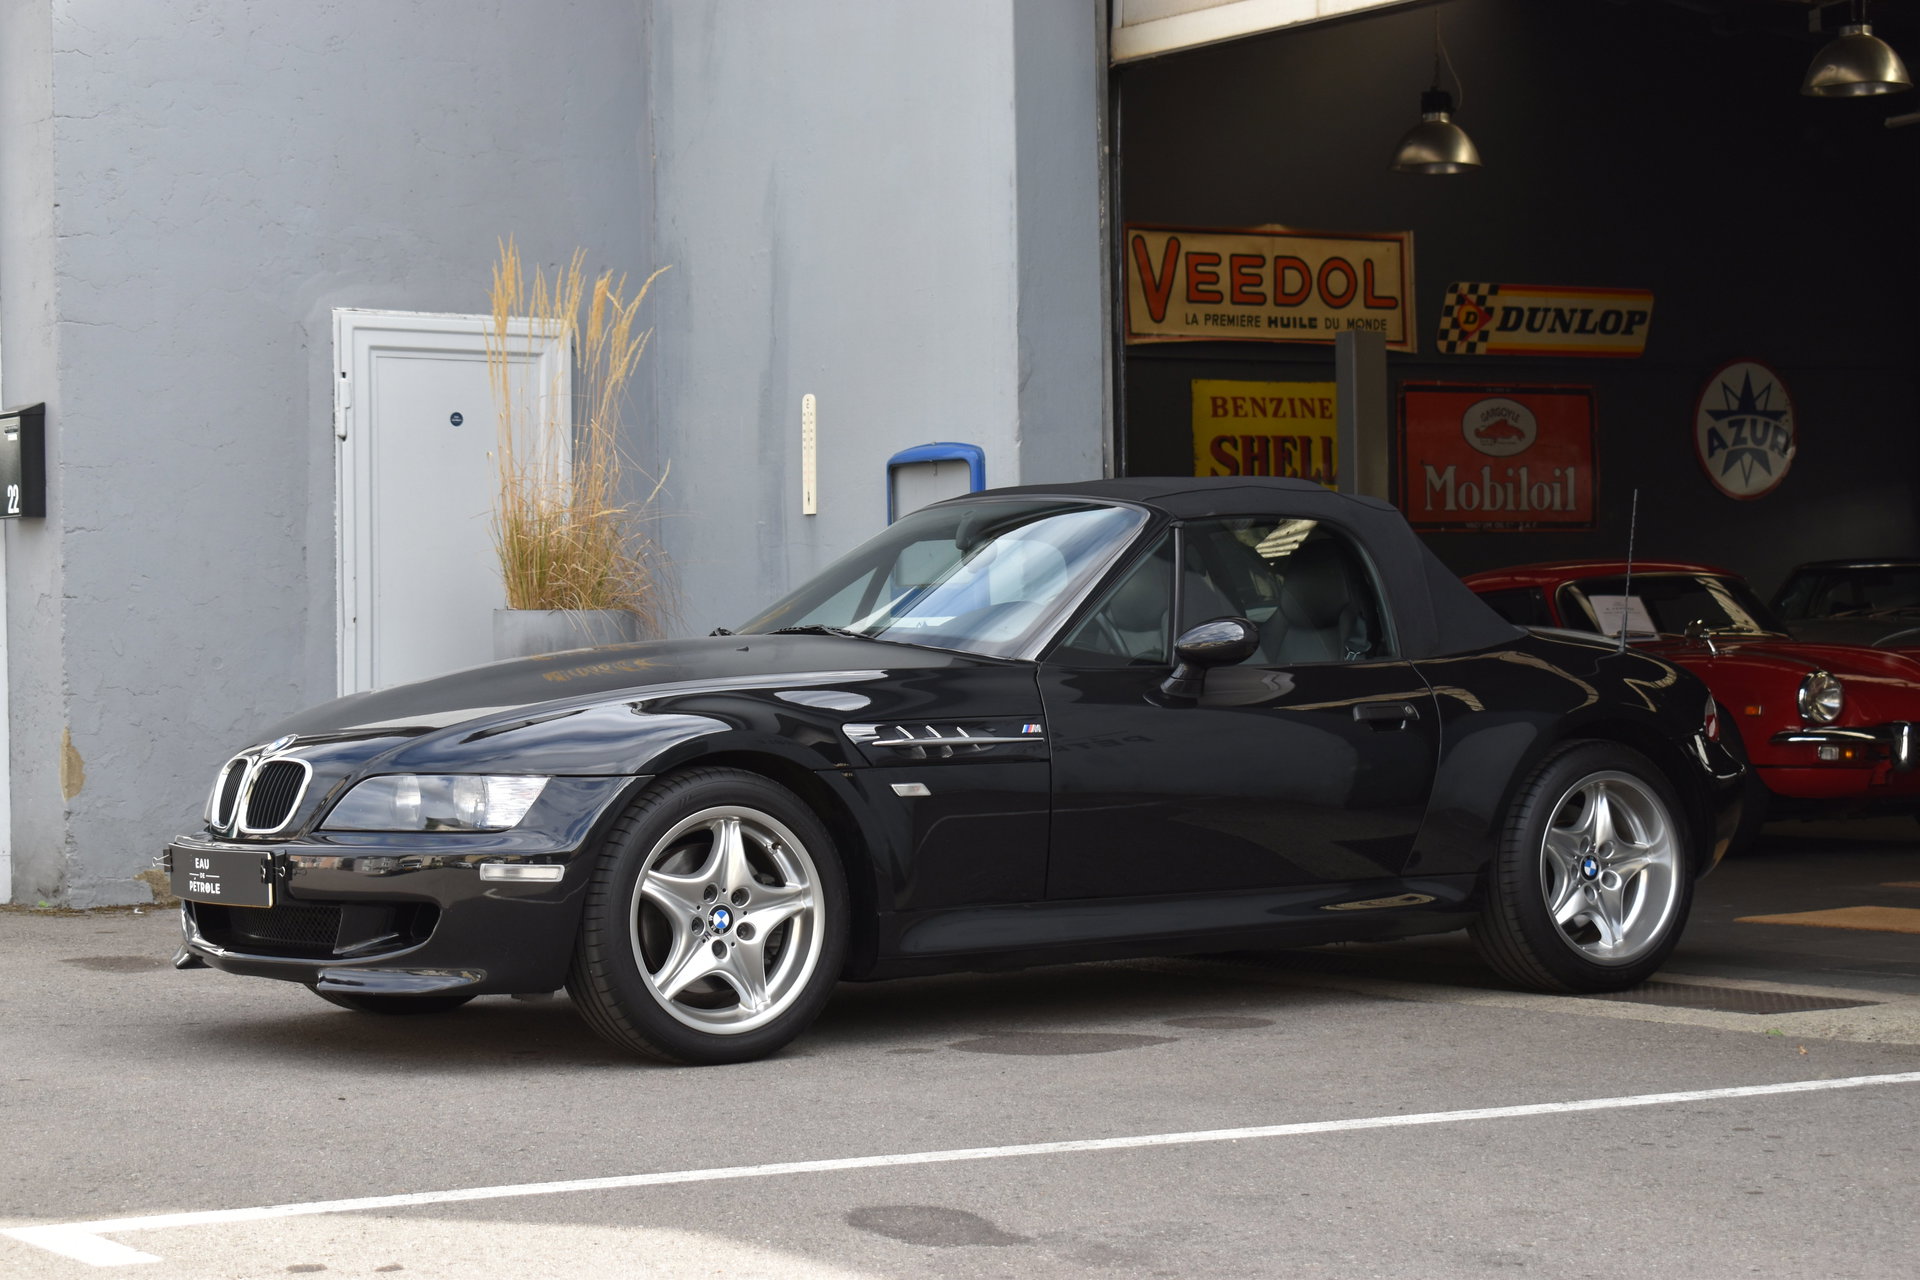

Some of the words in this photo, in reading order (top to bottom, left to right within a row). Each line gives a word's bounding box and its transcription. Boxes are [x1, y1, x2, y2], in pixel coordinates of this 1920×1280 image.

[1132, 234, 1398, 323] VEEDOL
[1185, 313, 1199, 325] LA
[1268, 316, 1318, 329] HUILE
[1325, 317, 1340, 330] DU
[1347, 318, 1387, 332] MONDE
[1463, 311, 1478, 325] D
[1496, 306, 1648, 335] DUNLOP
[1209, 396, 1333, 419] BENZINE
[1707, 418, 1789, 459] AZUR
[7, 484, 19, 514] 22
[1423, 464, 1577, 511] Mobiloil
[194, 857, 210, 869] EAU
[189, 877, 221, 895] PÉTROLE
